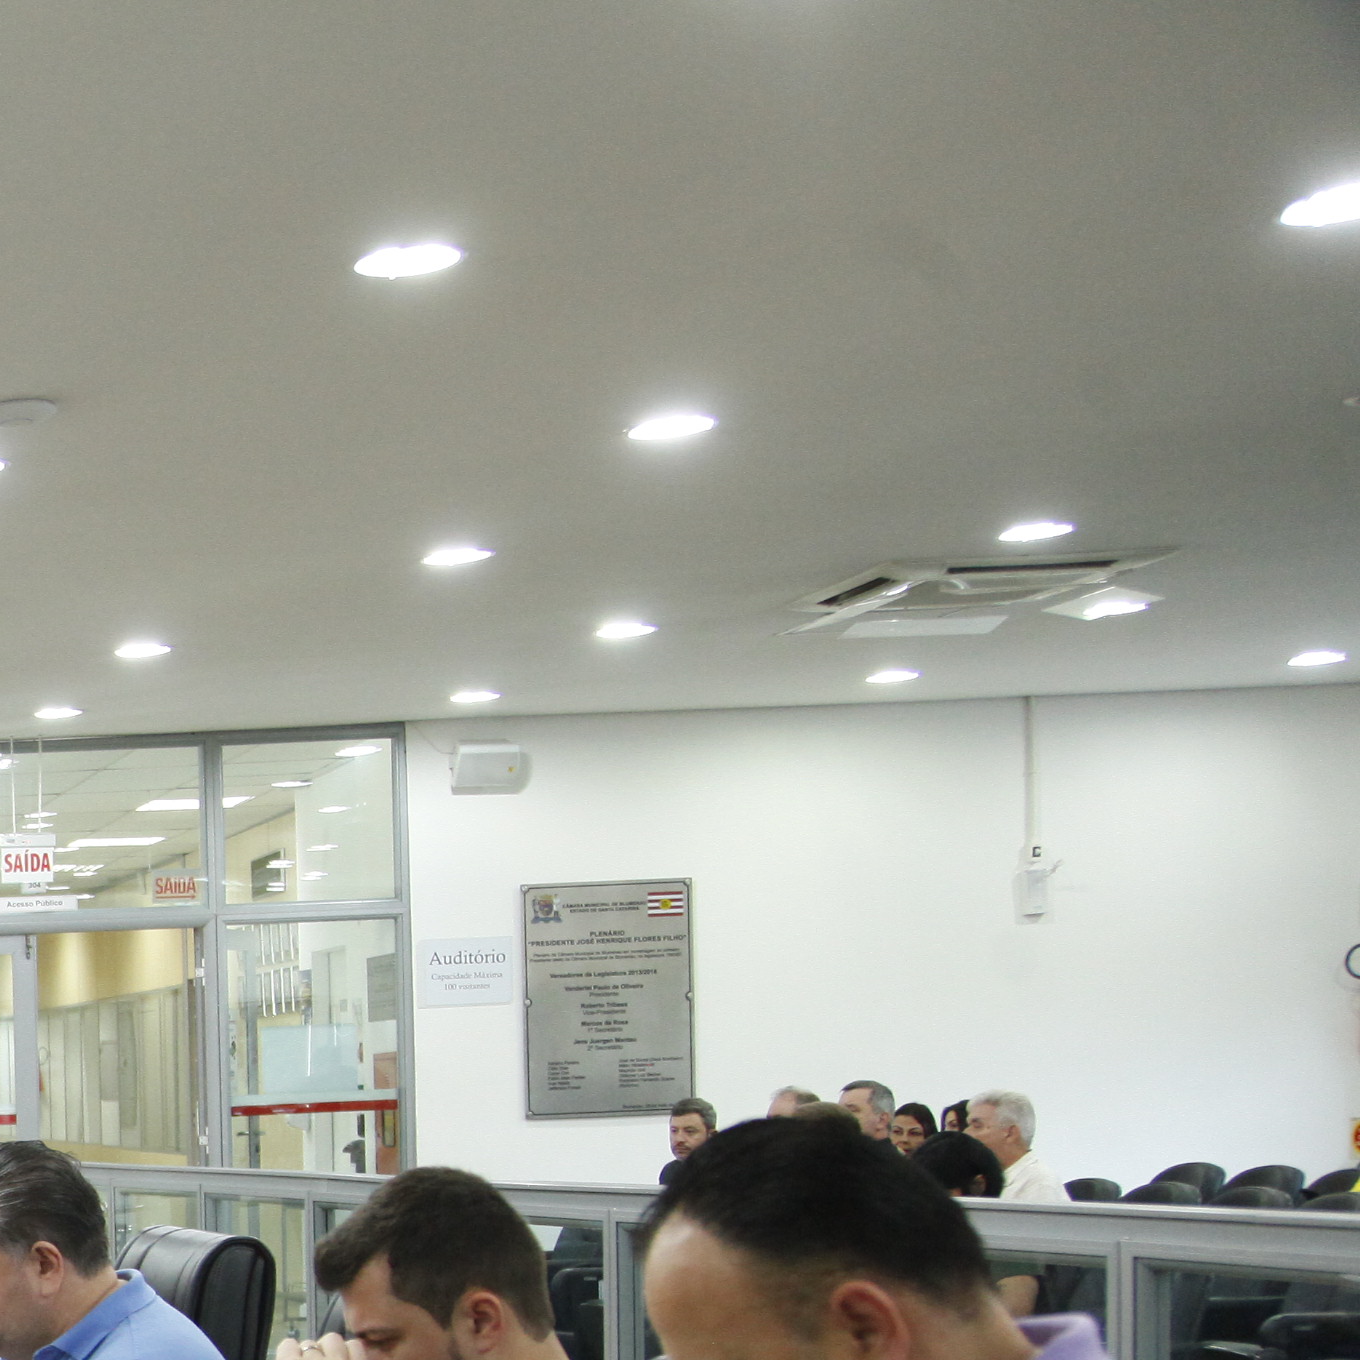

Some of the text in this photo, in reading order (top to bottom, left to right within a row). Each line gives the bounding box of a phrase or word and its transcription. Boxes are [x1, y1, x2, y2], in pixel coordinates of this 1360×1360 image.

[4, 850, 51, 873] SAÍDA
[35, 899, 63, 907] Público
[589, 929, 625, 937] PLENÁRIO
[576, 937, 594, 945] JOSÉ
[429, 949, 506, 966] Auditório
[431, 972, 472, 981] Capacidade
